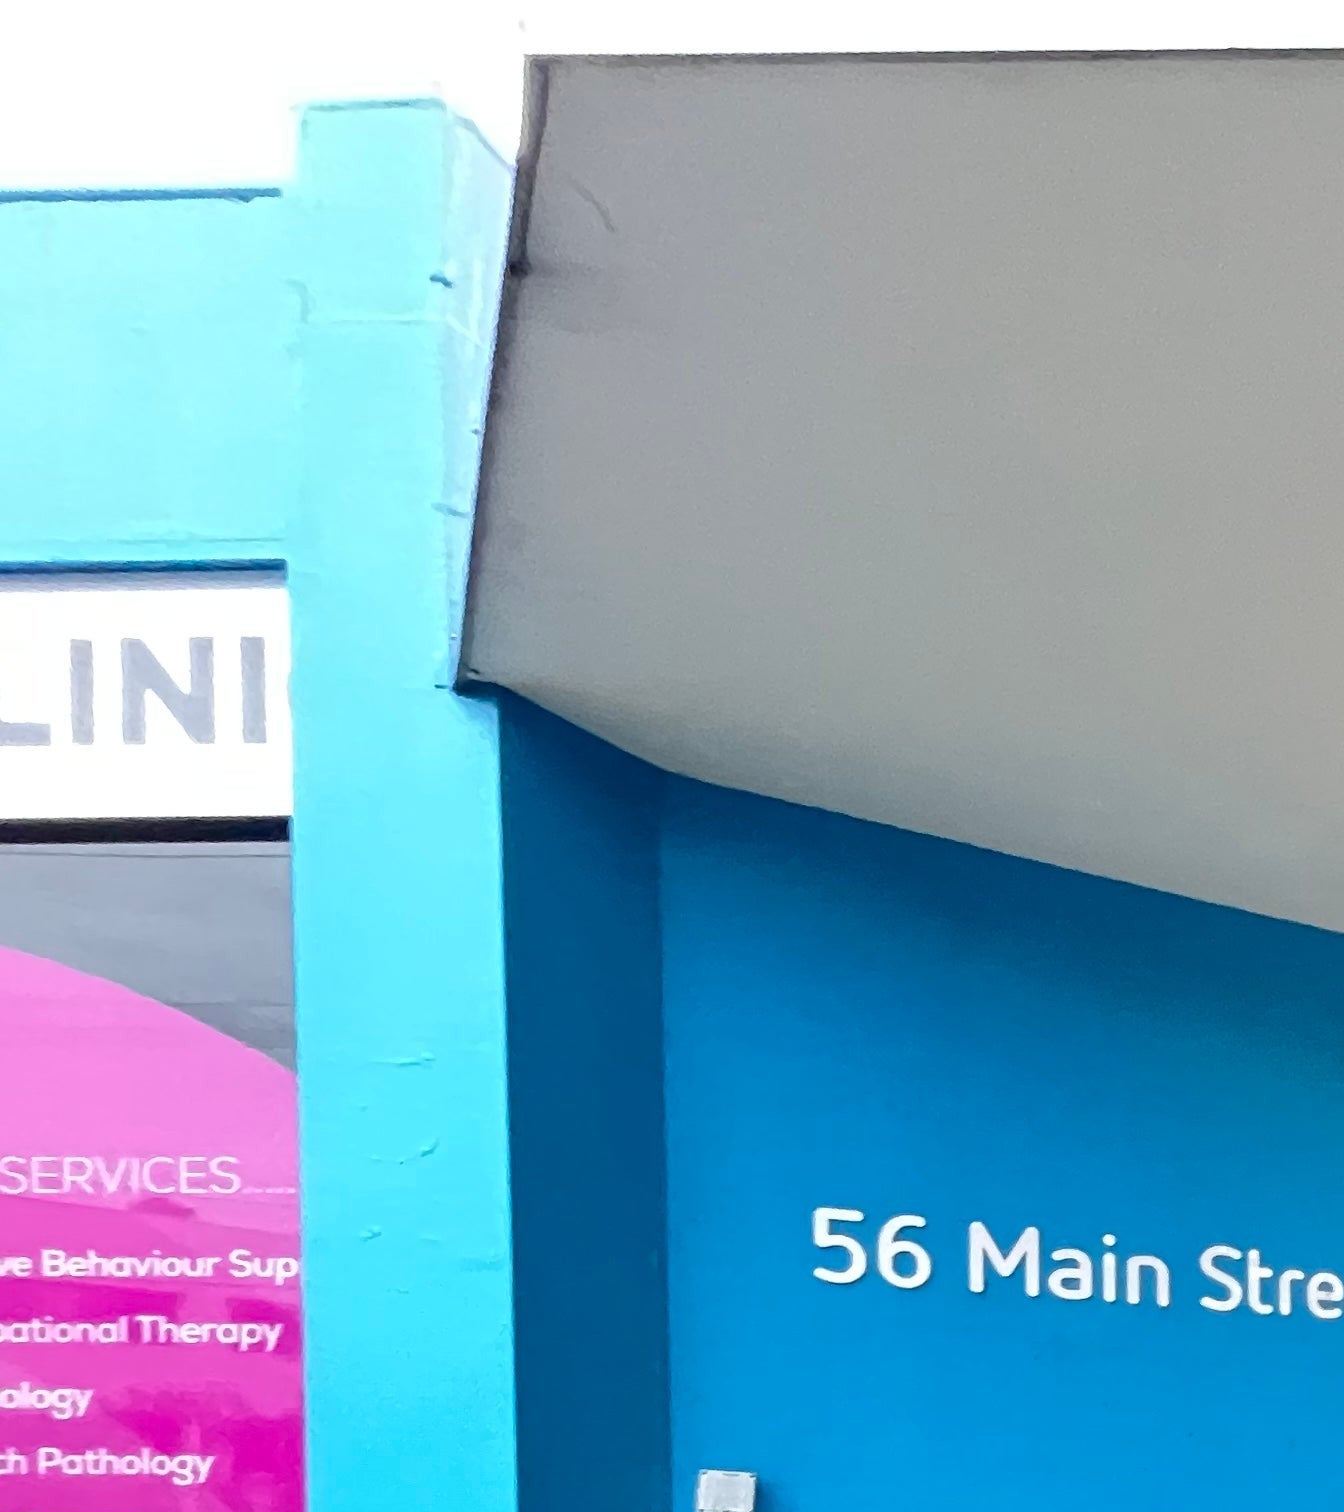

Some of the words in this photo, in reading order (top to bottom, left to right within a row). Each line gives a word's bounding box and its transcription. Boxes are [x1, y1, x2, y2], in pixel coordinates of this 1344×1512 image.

[0, 1155, 242, 1195] SERVICES
[41, 1249, 222, 1278] Behaviour
[811, 1205, 932, 1290] 56
[968, 1220, 1171, 1308] Main
[135, 1315, 284, 1352] Therapy
[38, 1447, 215, 1486] Pathology
